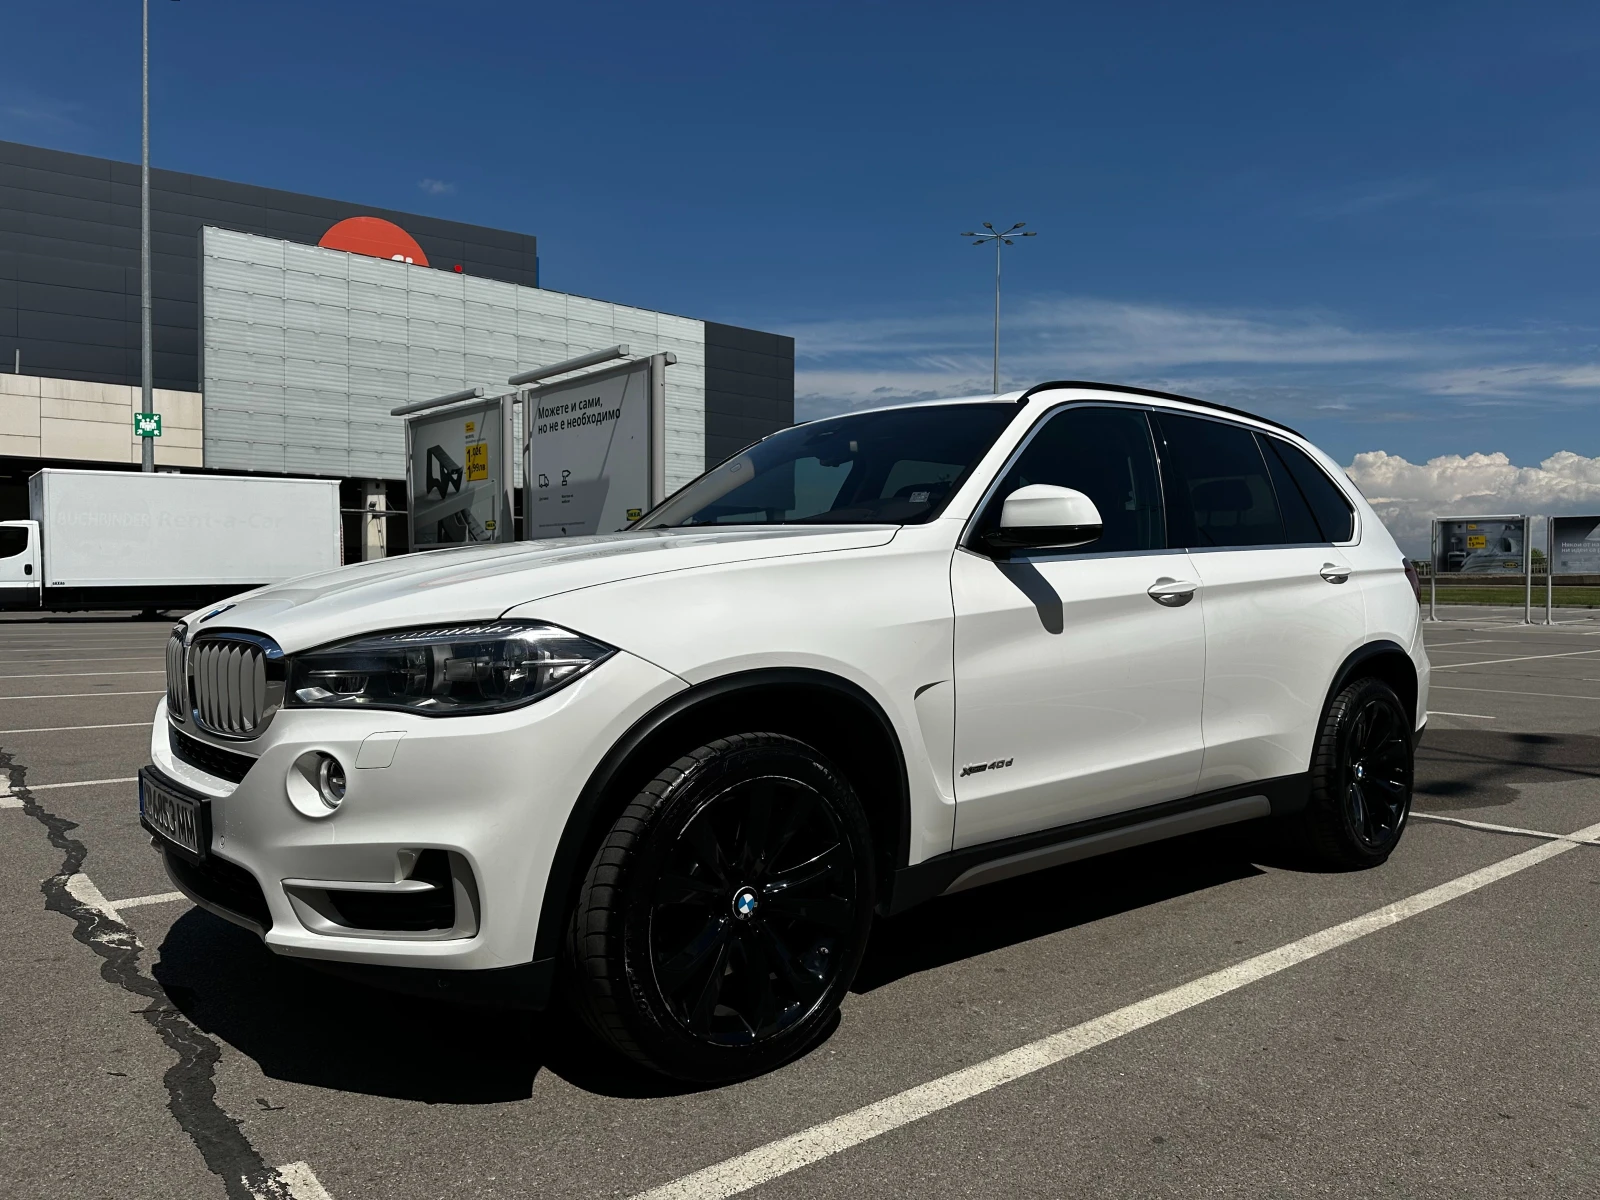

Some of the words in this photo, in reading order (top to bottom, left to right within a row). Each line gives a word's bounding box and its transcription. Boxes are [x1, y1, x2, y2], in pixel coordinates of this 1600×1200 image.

[538, 404, 569, 420] Можете
[571, 402, 577, 413] и
[579, 397, 603, 411] сами,
[538, 423, 548, 435] но
[549, 421, 559, 433] не
[560, 420, 565, 430] е
[567, 408, 621, 428] необходимо
